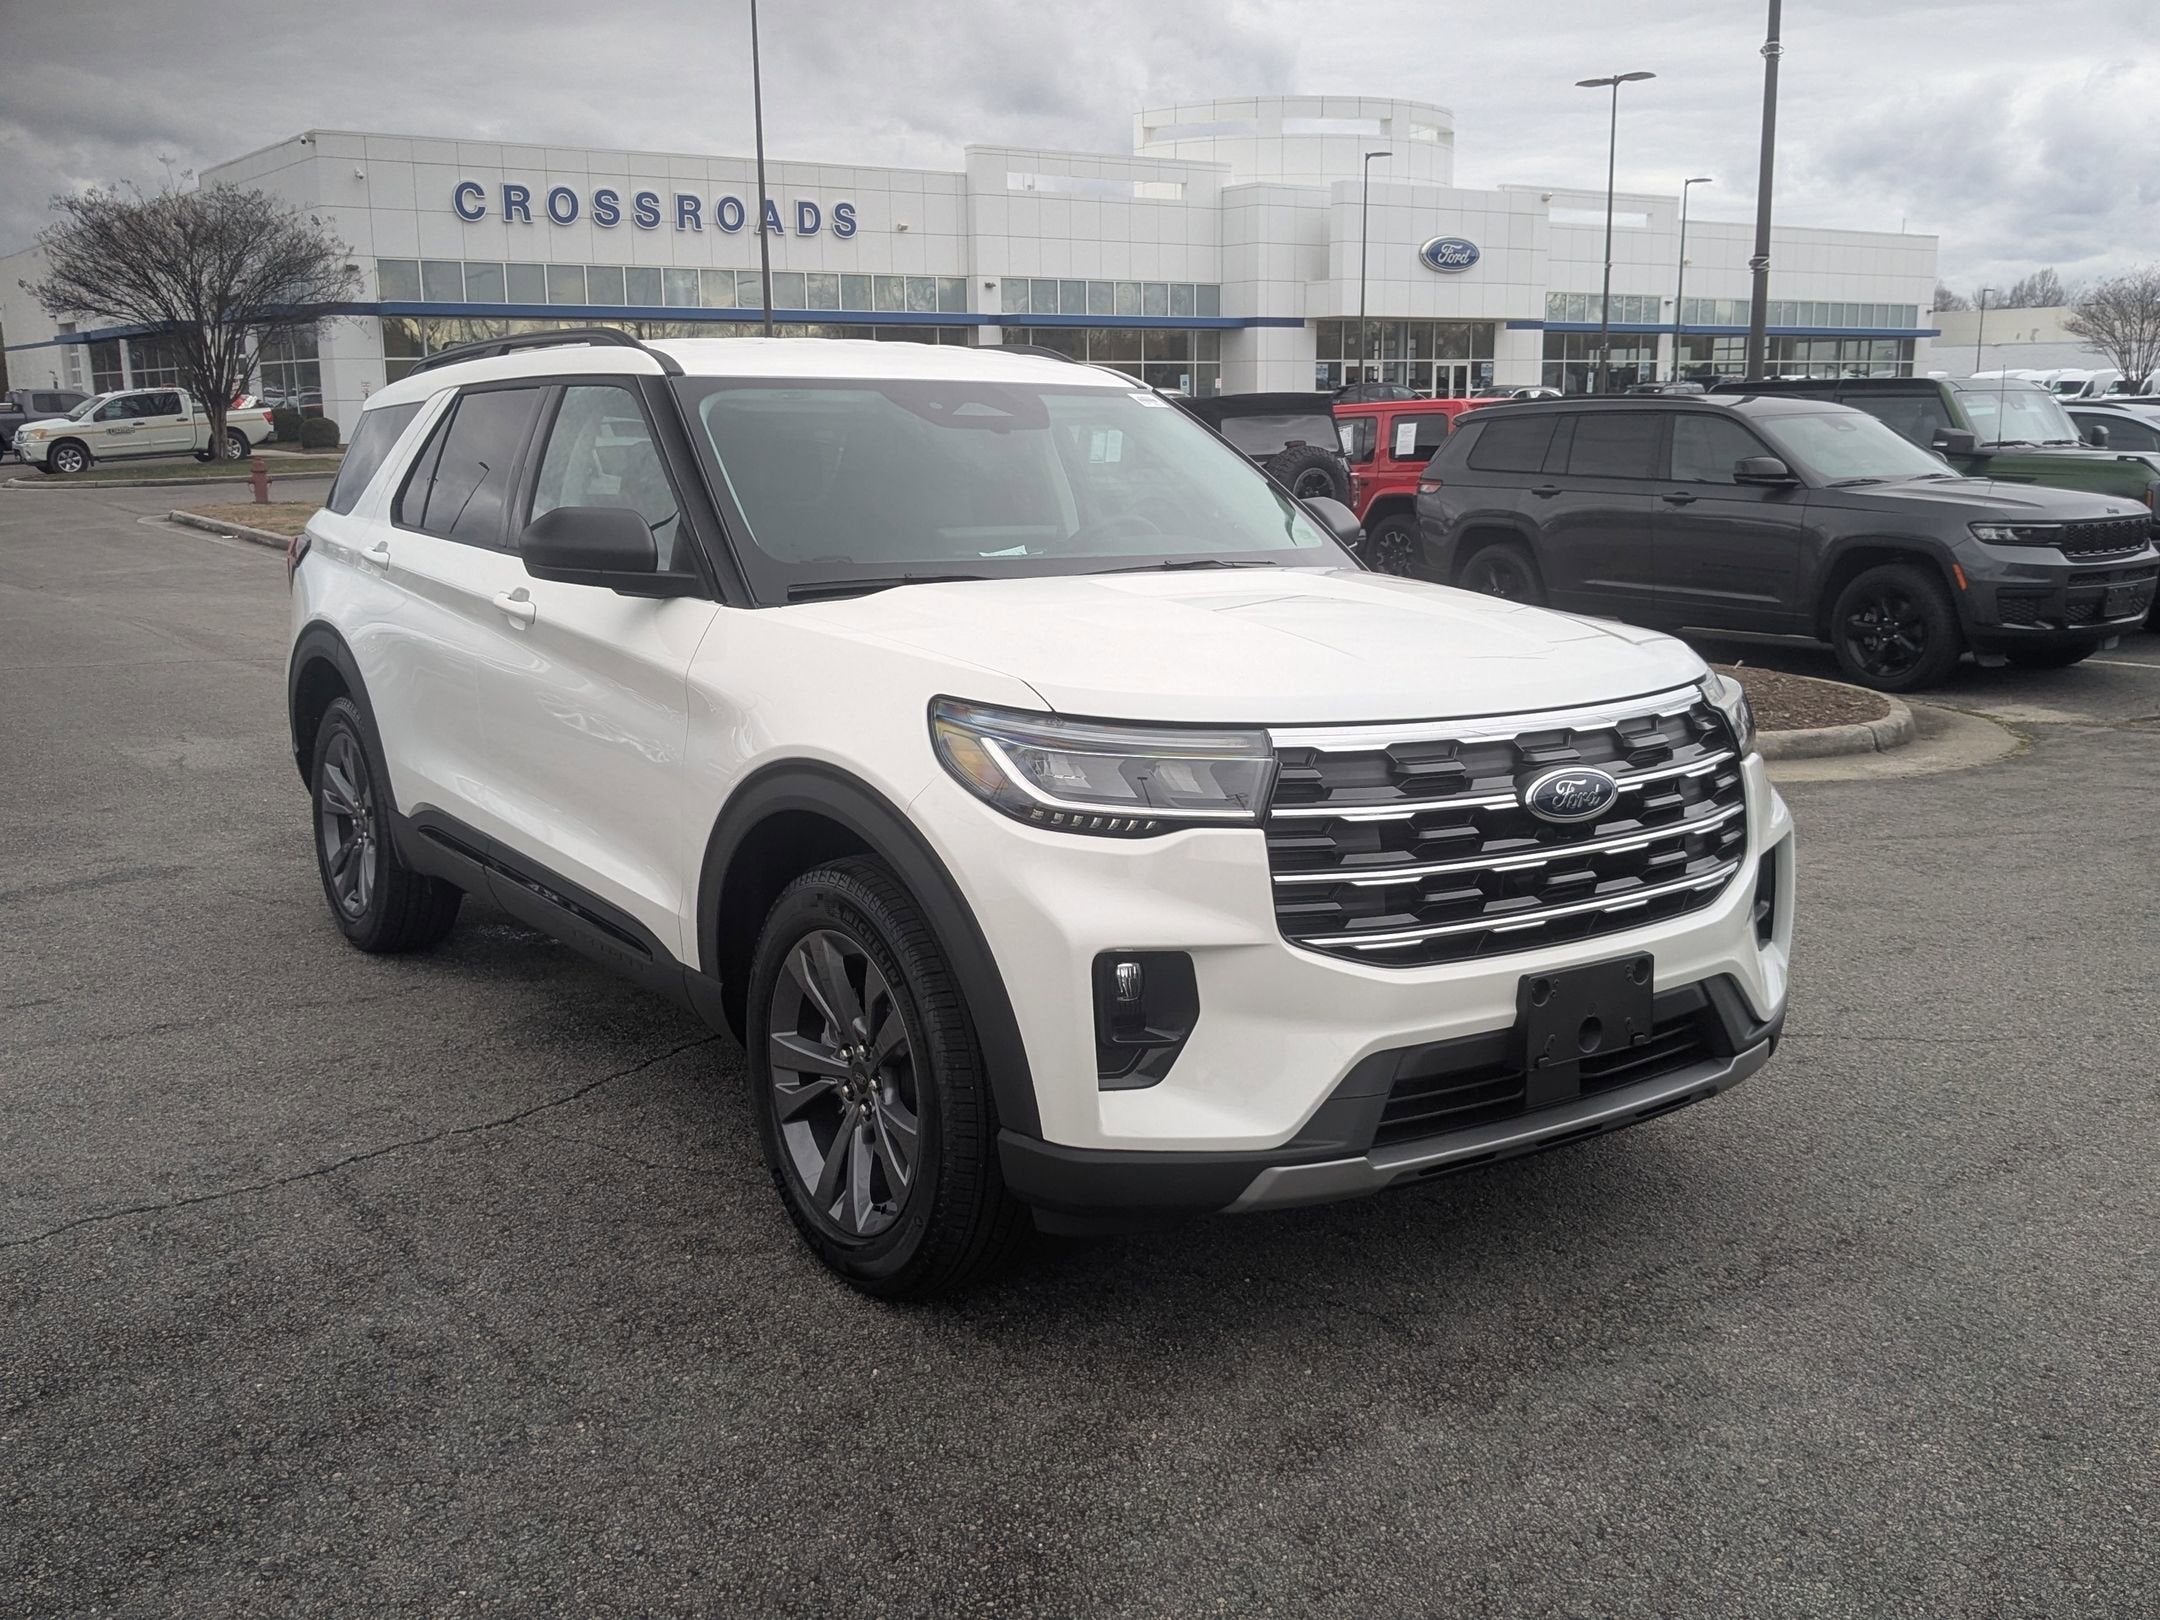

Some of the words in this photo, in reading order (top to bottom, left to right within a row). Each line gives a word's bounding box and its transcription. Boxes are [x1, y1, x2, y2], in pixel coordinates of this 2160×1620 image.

[453, 181, 857, 239] CROSSROADS
[1437, 243, 1470, 264] Ford
[1552, 779, 1601, 811] Ford
[839, 907, 904, 991] MICHELIN
